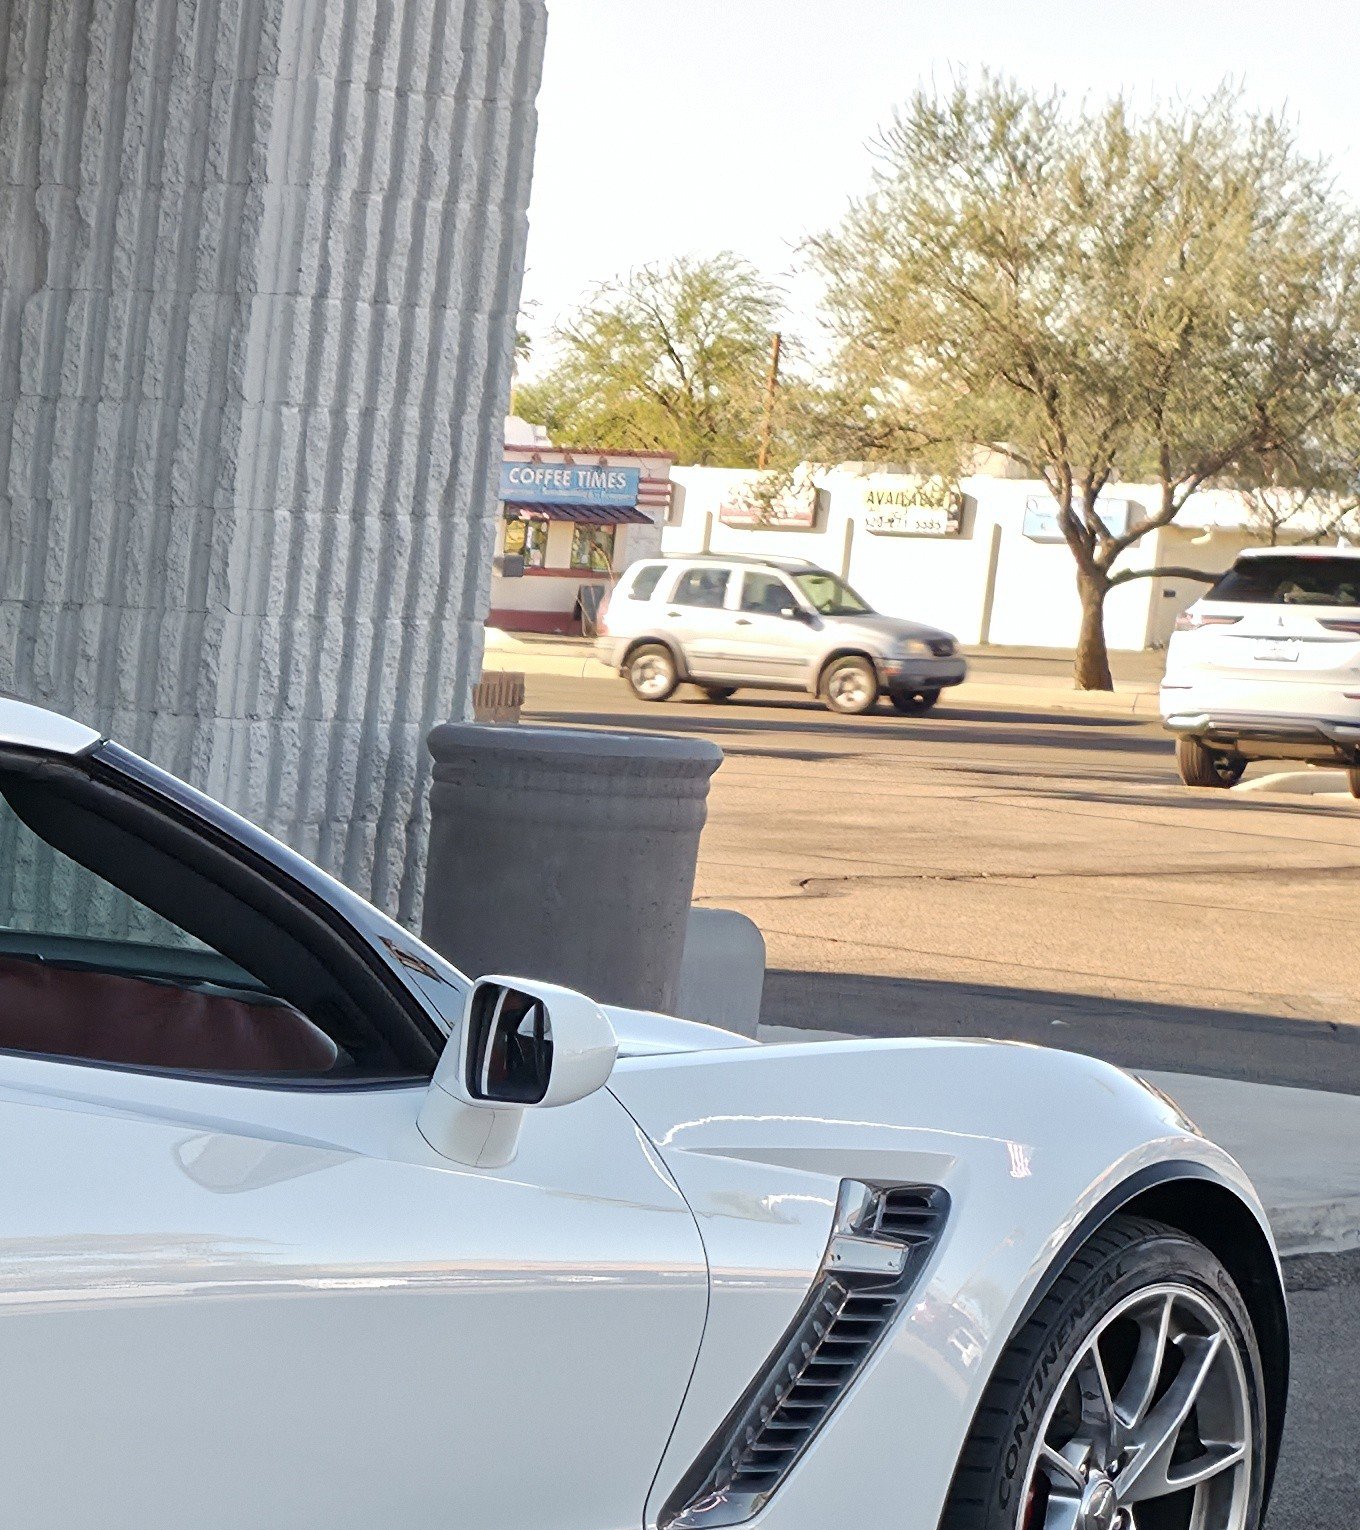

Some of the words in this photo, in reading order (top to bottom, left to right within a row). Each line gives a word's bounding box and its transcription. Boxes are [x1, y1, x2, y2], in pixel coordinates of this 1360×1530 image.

[509, 467, 572, 488] COFFEE
[578, 470, 627, 490] TIMES
[998, 1262, 1127, 1511] CONTINENTAL
